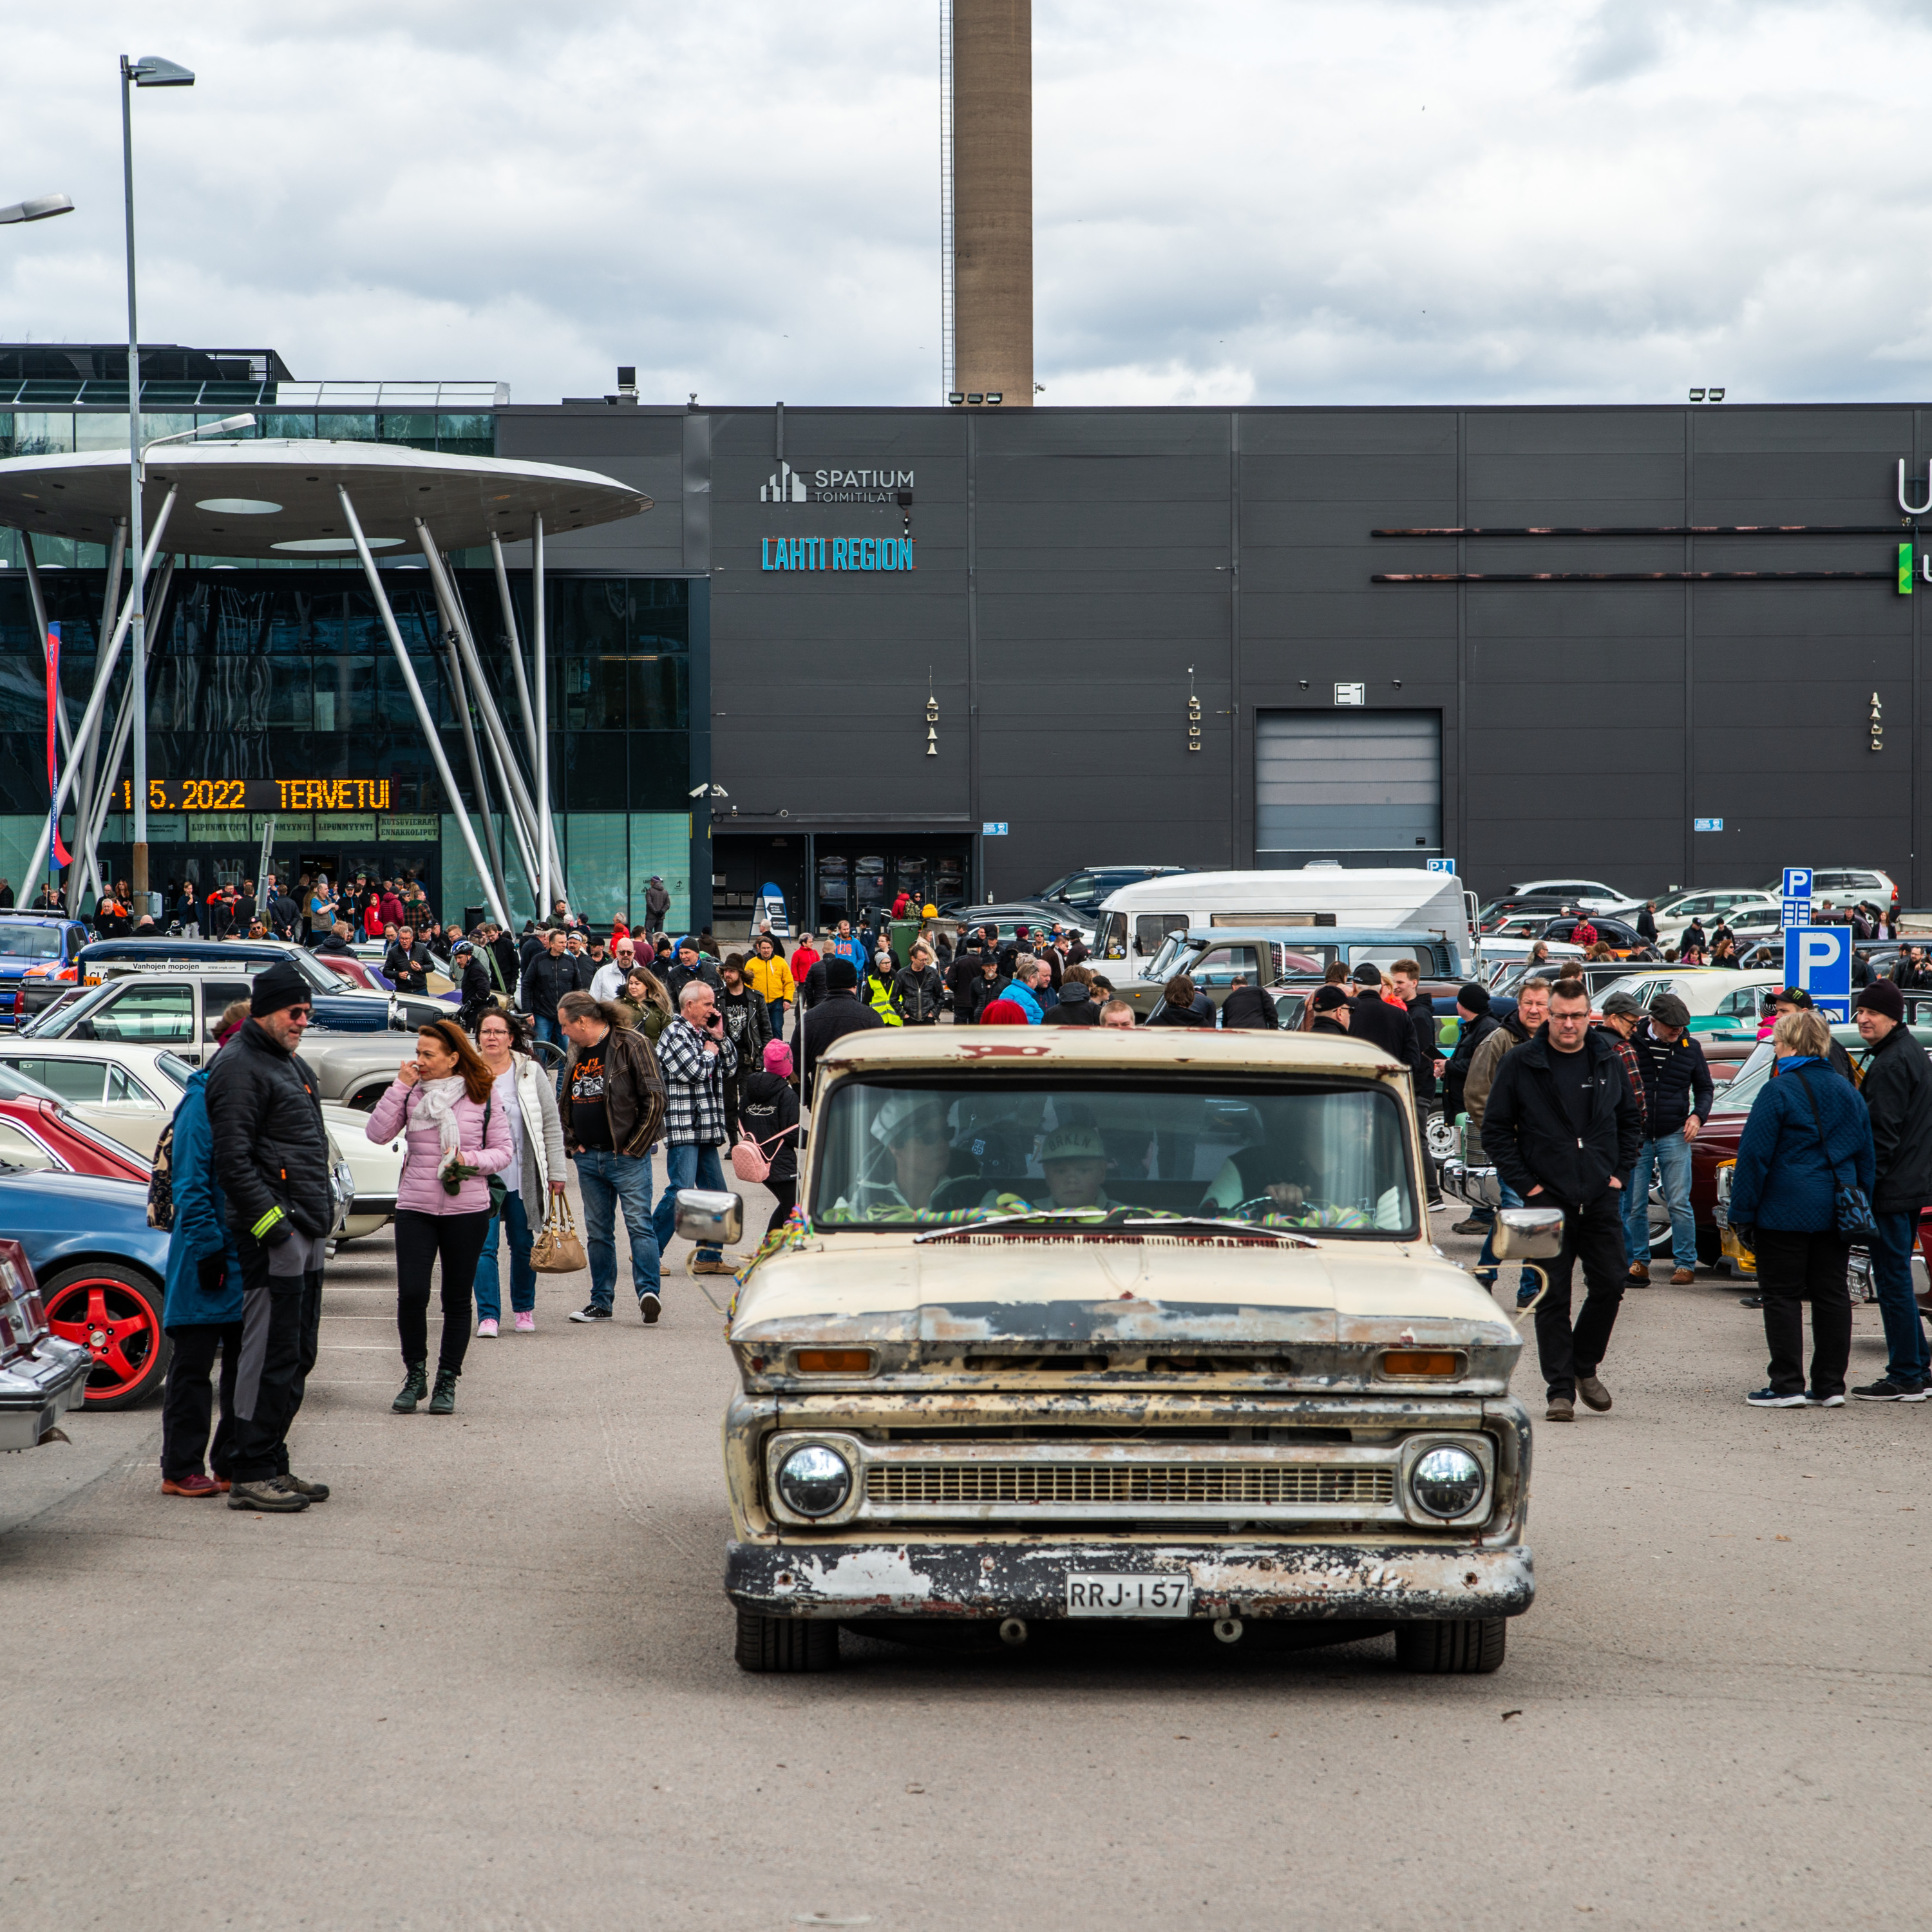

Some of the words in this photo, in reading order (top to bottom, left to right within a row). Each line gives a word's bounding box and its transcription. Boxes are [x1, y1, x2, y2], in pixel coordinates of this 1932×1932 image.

[815, 469, 914, 488] SPATIUM
[815, 492, 894, 503] TOIMITILAT
[762, 538, 825, 571] LAHTI
[833, 538, 913, 571] REGION
[1336, 685, 1363, 704] E1
[192, 823, 247, 831] LIPUNMYYNTI
[1789, 871, 1808, 895] P
[1799, 932, 1841, 990] P
